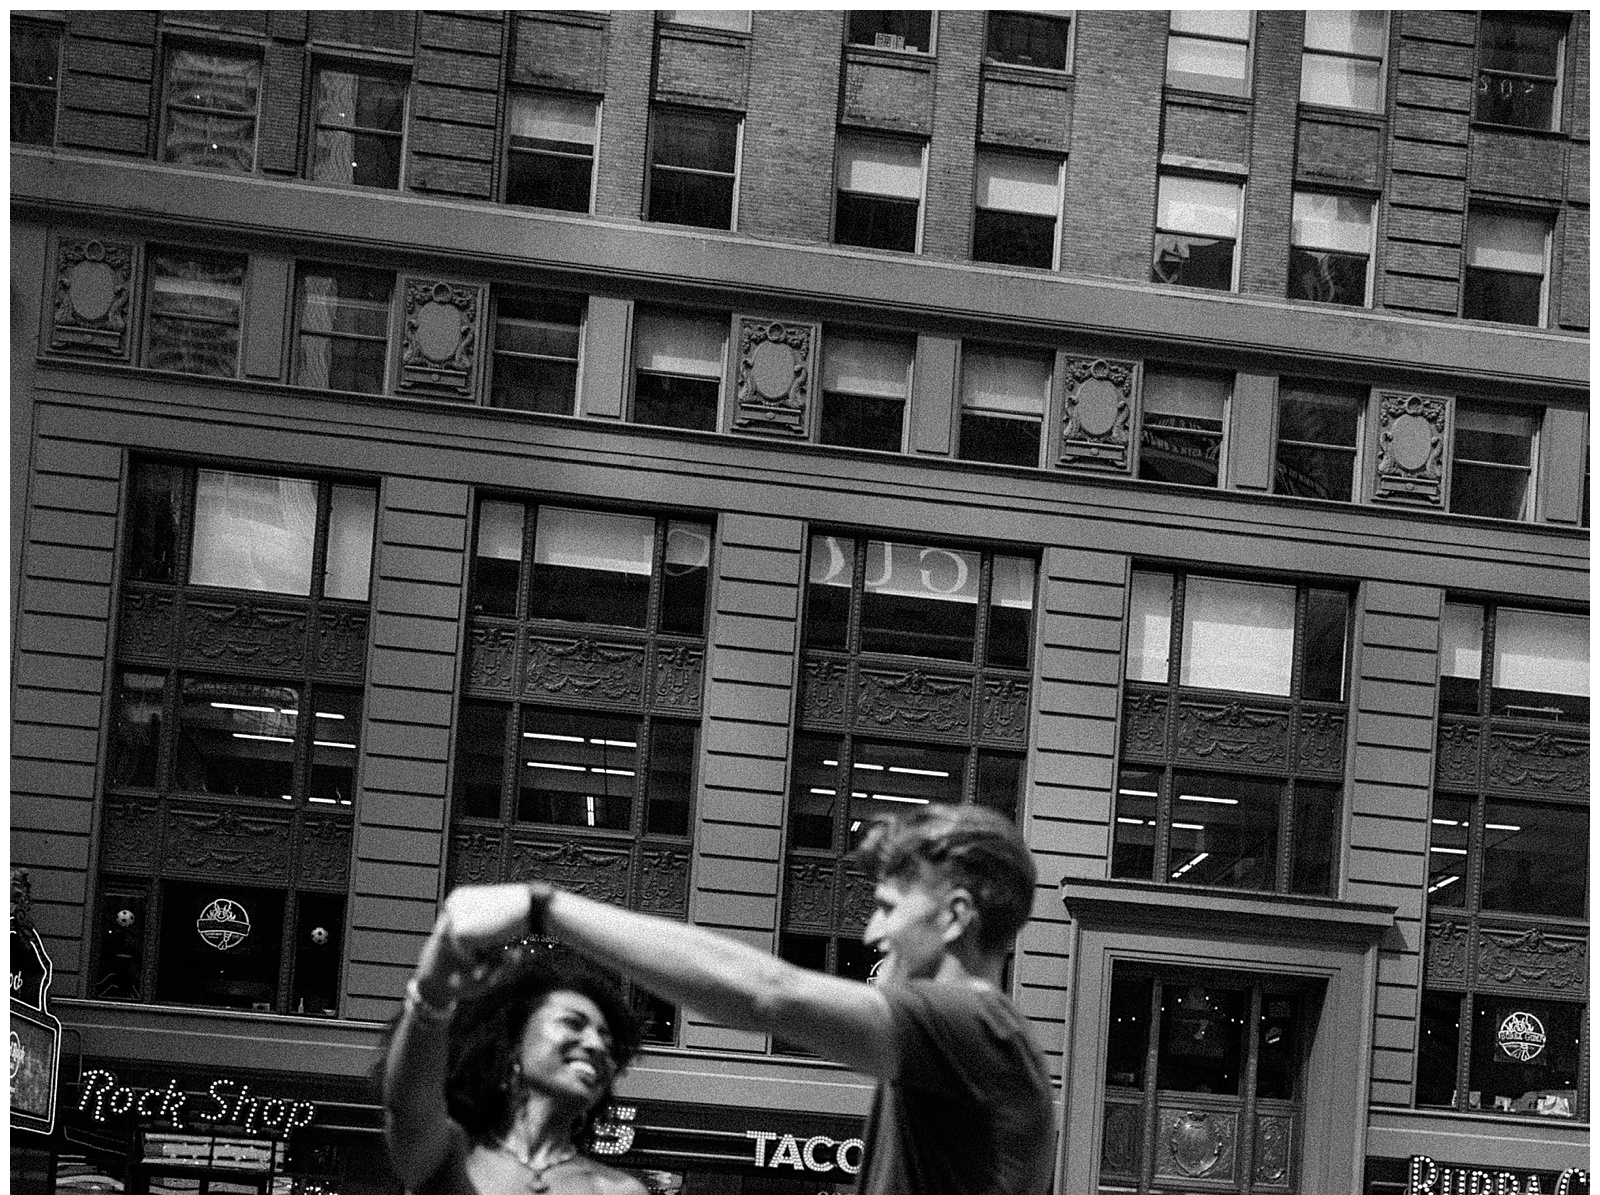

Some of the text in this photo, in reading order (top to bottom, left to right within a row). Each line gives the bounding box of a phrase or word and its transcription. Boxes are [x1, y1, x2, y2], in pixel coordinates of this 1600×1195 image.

[78, 1069, 314, 1138] Rock Shop
[746, 1130, 866, 1174] TACO
